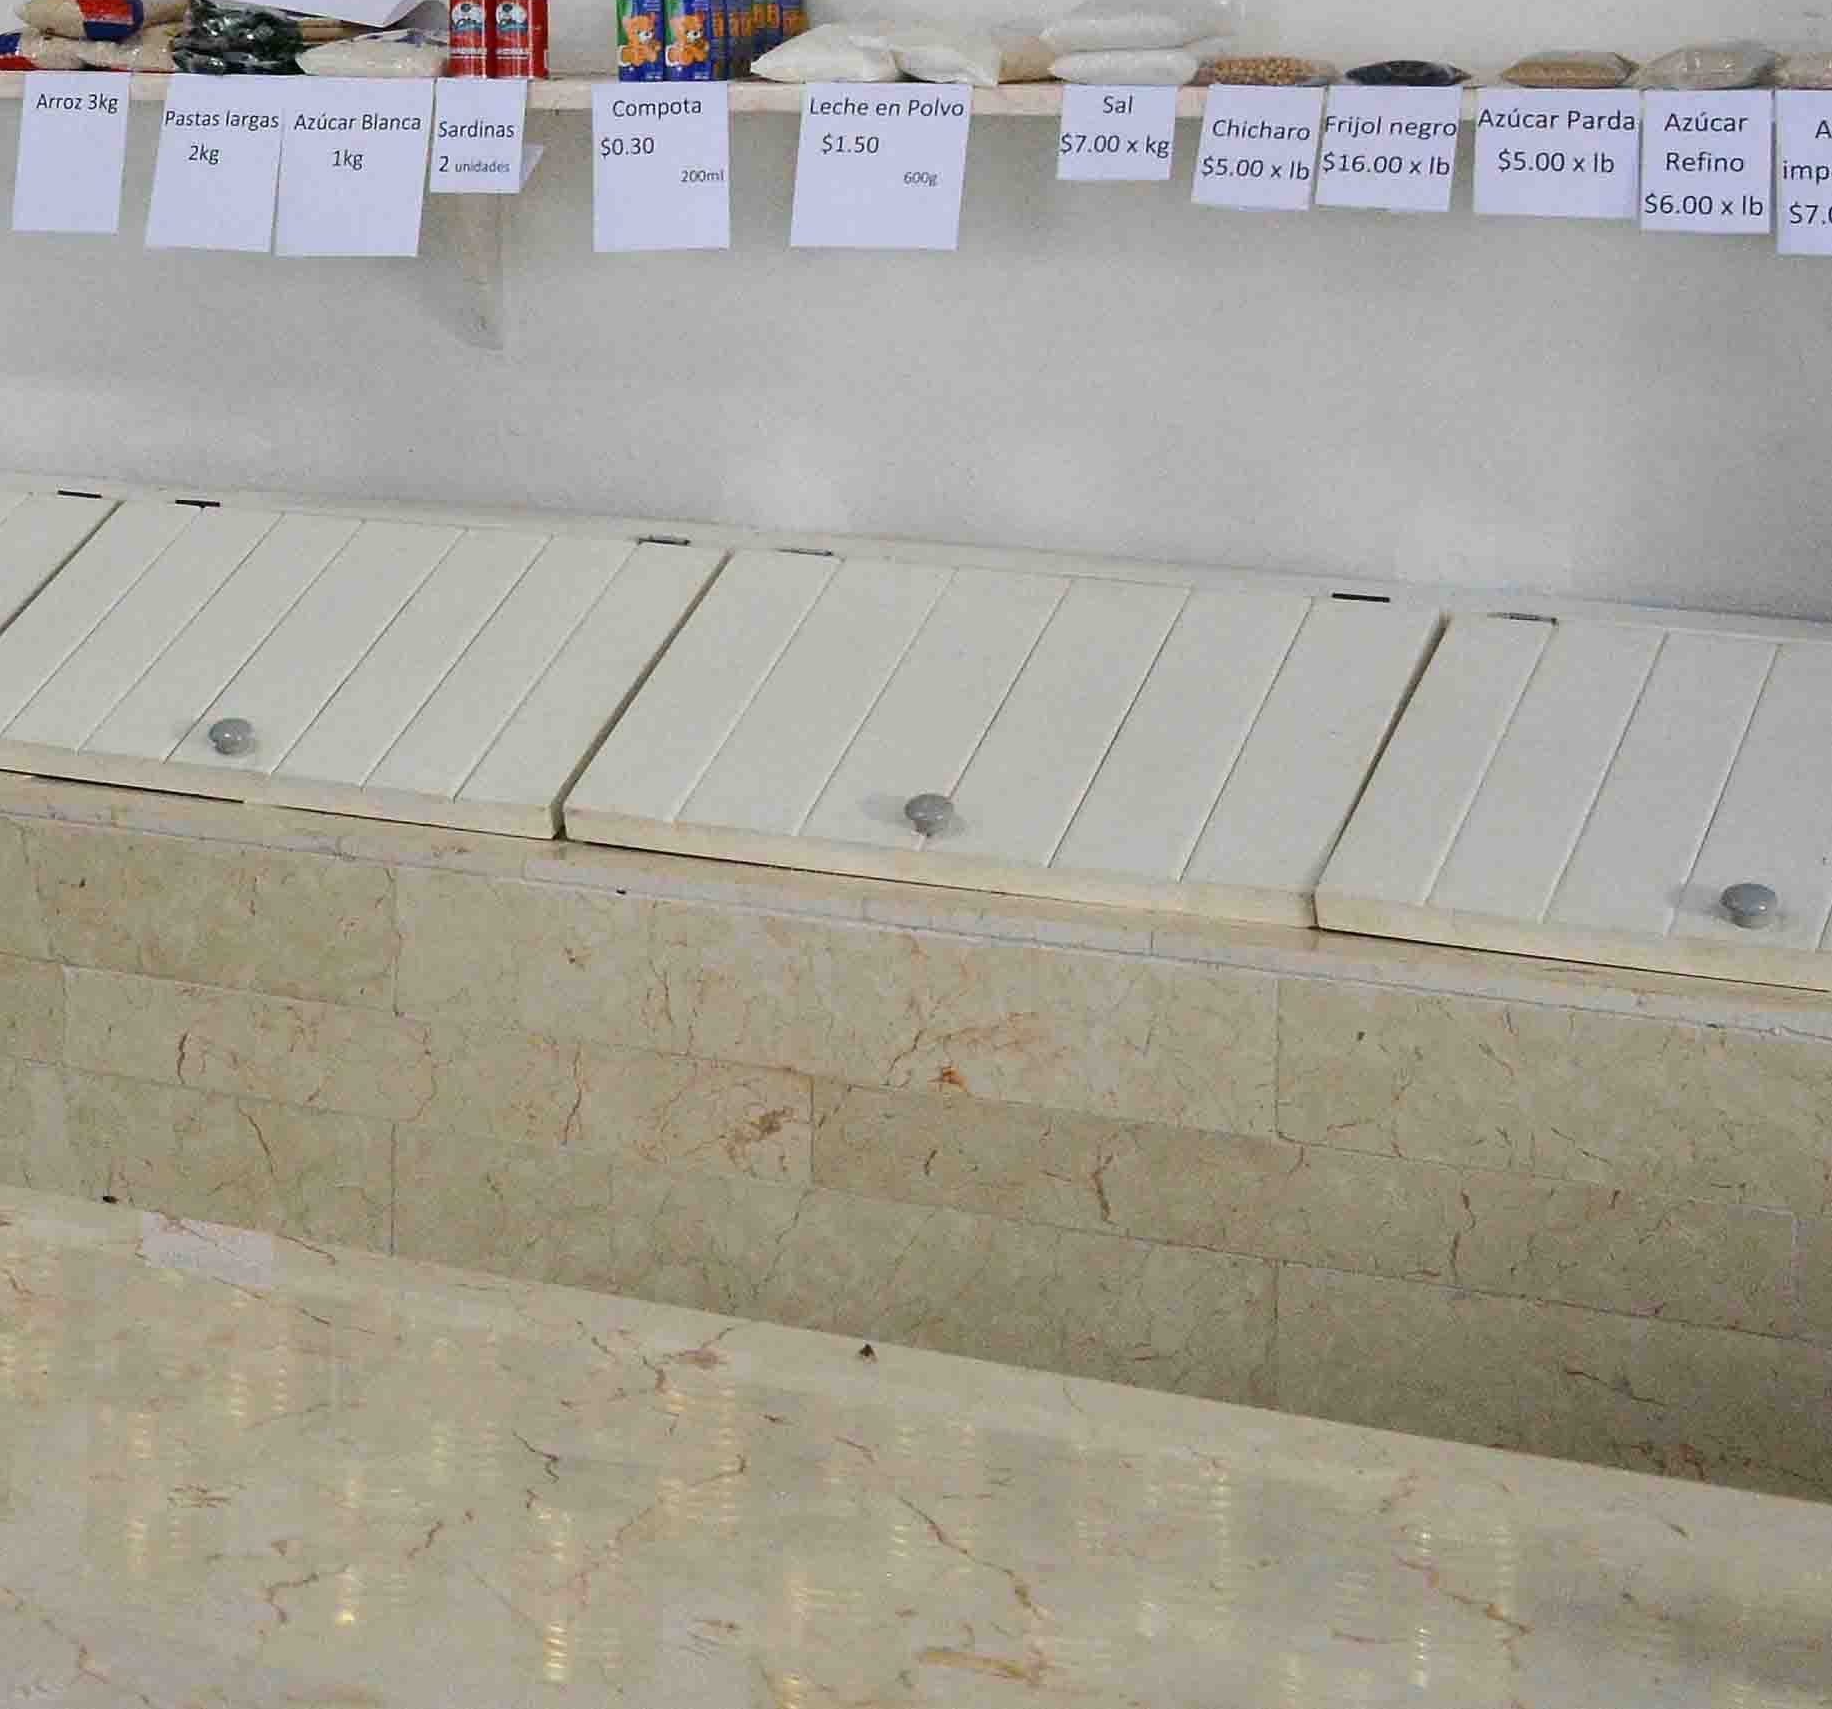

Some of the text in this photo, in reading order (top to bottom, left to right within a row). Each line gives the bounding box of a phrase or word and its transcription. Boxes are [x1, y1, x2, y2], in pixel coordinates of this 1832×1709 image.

[36, 93, 118, 114] Arroz 3kg
[612, 97, 702, 120] Compota
[809, 97, 964, 117] Leche en Polvo
[1102, 95, 1133, 115] Sal
[164, 110, 280, 131] Pastas largas
[294, 109, 422, 131] Azúcar Blanca
[438, 120, 515, 138] Sardinas
[1211, 119, 1311, 141] Chicharo
[1324, 115, 1457, 140] Frijol negro
[1477, 108, 1635, 131] Azúcar Parda
[1664, 111, 1749, 133] Azúcar
[187, 144, 220, 165] 2kg
[600, 137, 655, 159] $0.30
[821, 133, 880, 155] $1.50
[1060, 133, 1169, 159] $7.00 x kg
[332, 150, 364, 170] 1kg
[438, 155, 511, 173] 2 unidades
[1201, 156, 1310, 180] $5.00 x lb
[1322, 150, 1451, 175] $16.00 x lb
[1497, 148, 1615, 173] $5.00 x lb
[1665, 151, 1745, 173] Refino
[680, 169, 725, 183] 200ml
[903, 171, 937, 187] 600g
[1644, 193, 1764, 216] $6.00 x lb
